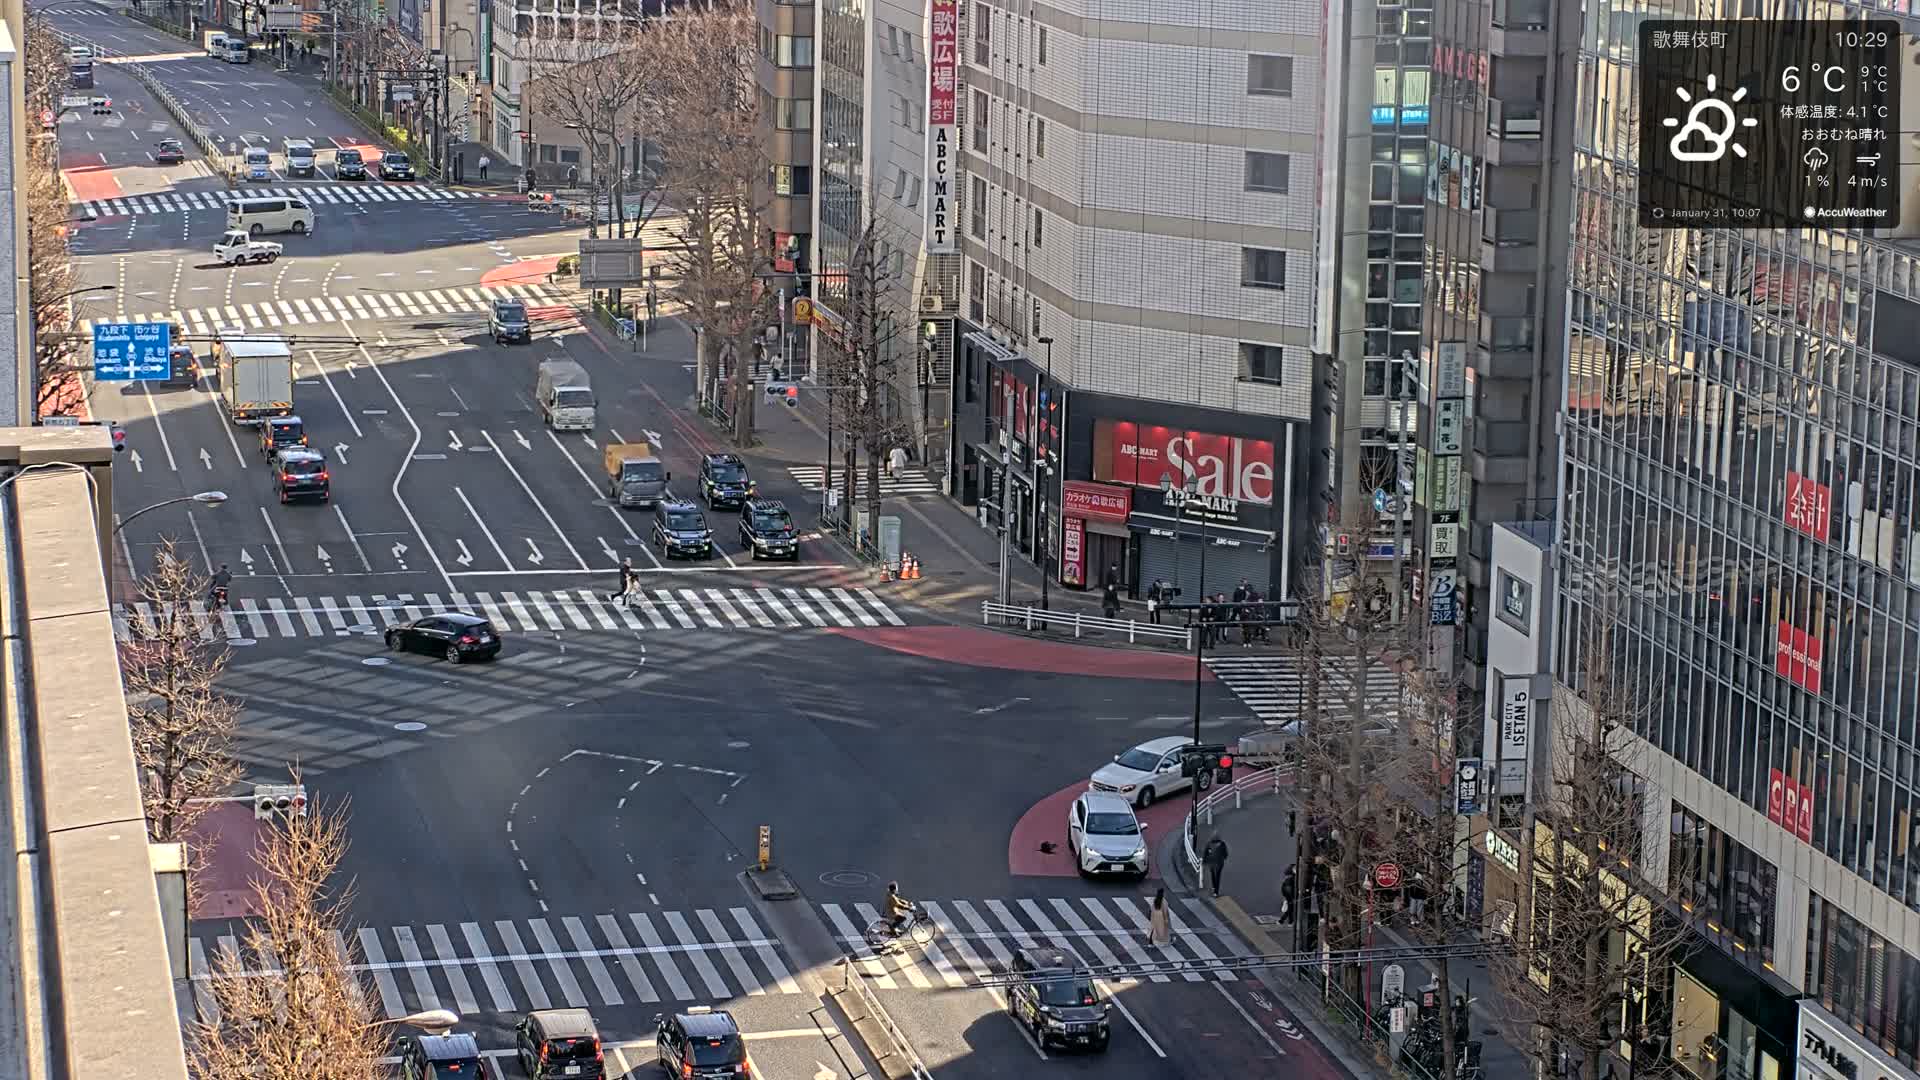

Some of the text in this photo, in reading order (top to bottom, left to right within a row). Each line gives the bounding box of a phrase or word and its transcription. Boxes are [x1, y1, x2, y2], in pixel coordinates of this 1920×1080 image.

[933, 11, 954, 92] 歌広場
[932, 99, 953, 109] 受付
[932, 110, 953, 120] 5F
[935, 128, 947, 243] ABC-MART
[100, 325, 129, 335] 九段下
[1120, 443, 1158, 457] ABCMART
[1167, 437, 1273, 502] Sale
[1066, 492, 1091, 504] カラオケ
[1165, 489, 1238, 513] ABMART
[1789, 481, 1826, 531] 会計
[1440, 514, 1451, 522] 7F
[1435, 527, 1448, 554] 買取
[1504, 702, 1514, 740] PARK CITY
[1513, 691, 1527, 747] ISETAN 5
[1771, 780, 1810, 830] CPA
